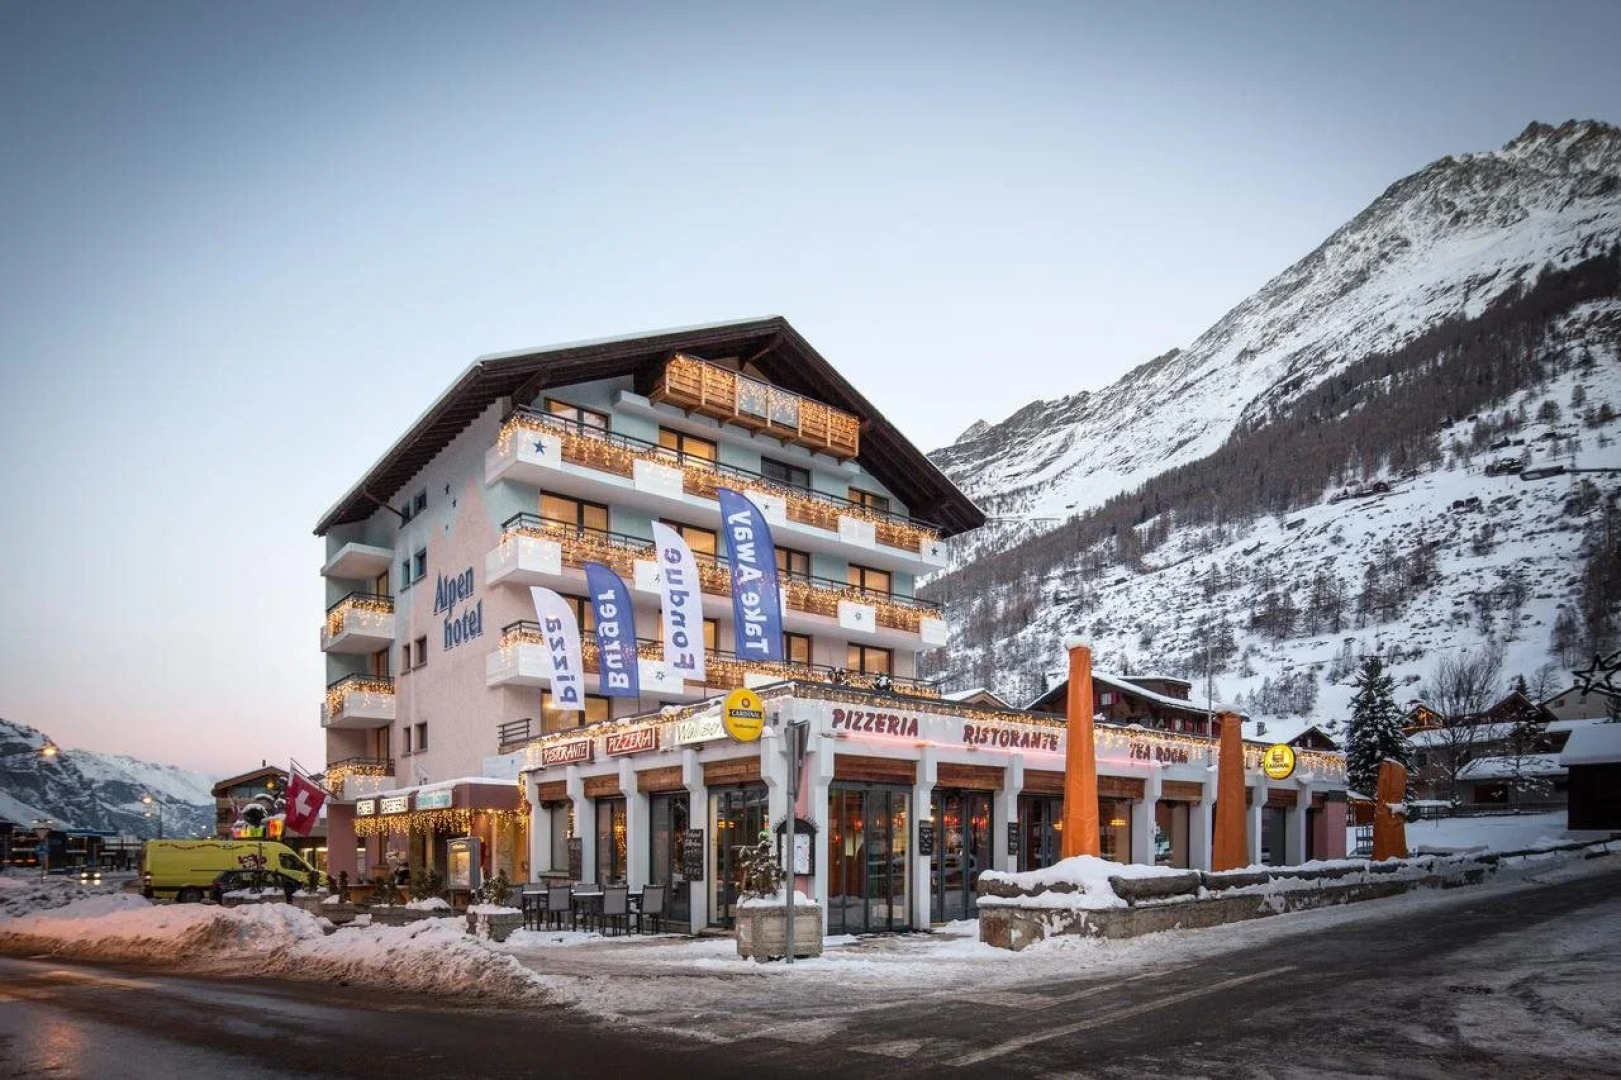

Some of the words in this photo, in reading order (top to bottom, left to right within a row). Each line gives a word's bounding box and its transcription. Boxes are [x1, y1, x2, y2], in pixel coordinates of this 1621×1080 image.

[434, 566, 474, 616] Alpen
[444, 598, 484, 651] hotel
[832, 708, 919, 737] PIZZERIA
[608, 729, 651, 752] PIZZERIA
[963, 725, 1059, 751] RISTORANTE
